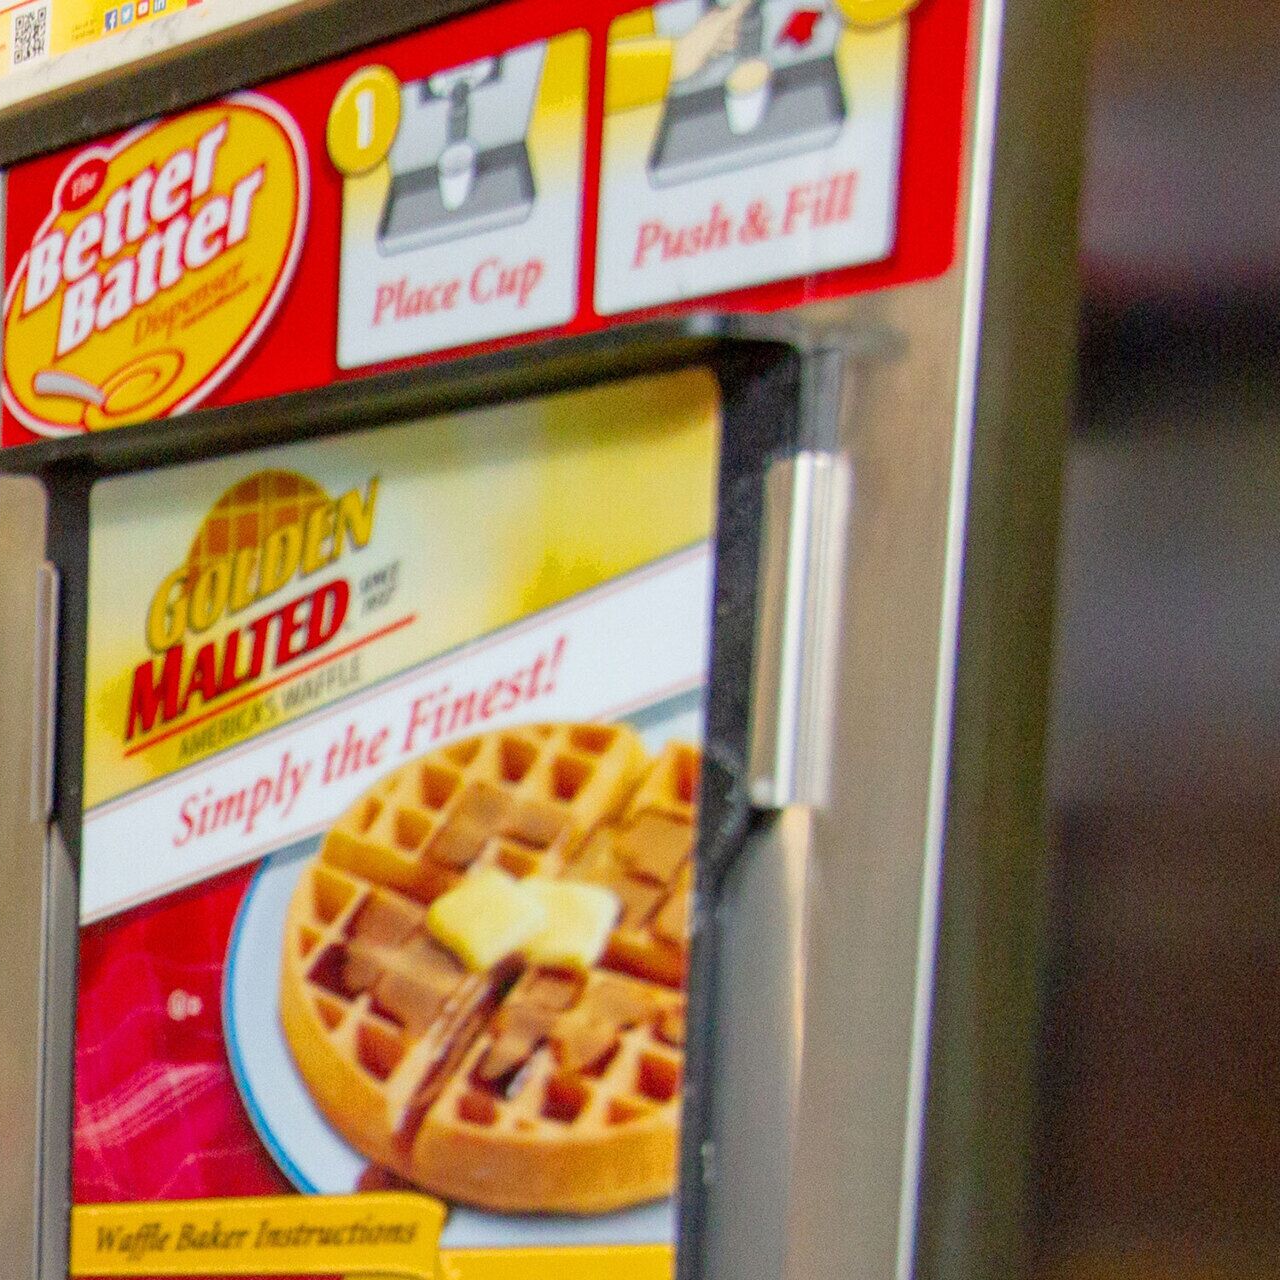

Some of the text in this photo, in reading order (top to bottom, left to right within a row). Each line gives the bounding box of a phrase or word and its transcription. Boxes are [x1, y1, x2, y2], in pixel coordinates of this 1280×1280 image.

[354, 89, 375, 150] 1
[21, 118, 228, 315] Better
[56, 163, 265, 357] Batter
[371, 257, 543, 327] Place Cup
[631, 168, 859, 269] Push & Fill
[146, 473, 380, 653] GOLDEN
[125, 577, 350, 743] MALTED
[173, 636, 567, 848] Simply the Finest!
[96, 1213, 418, 1262] Waffle Baker Instructions
